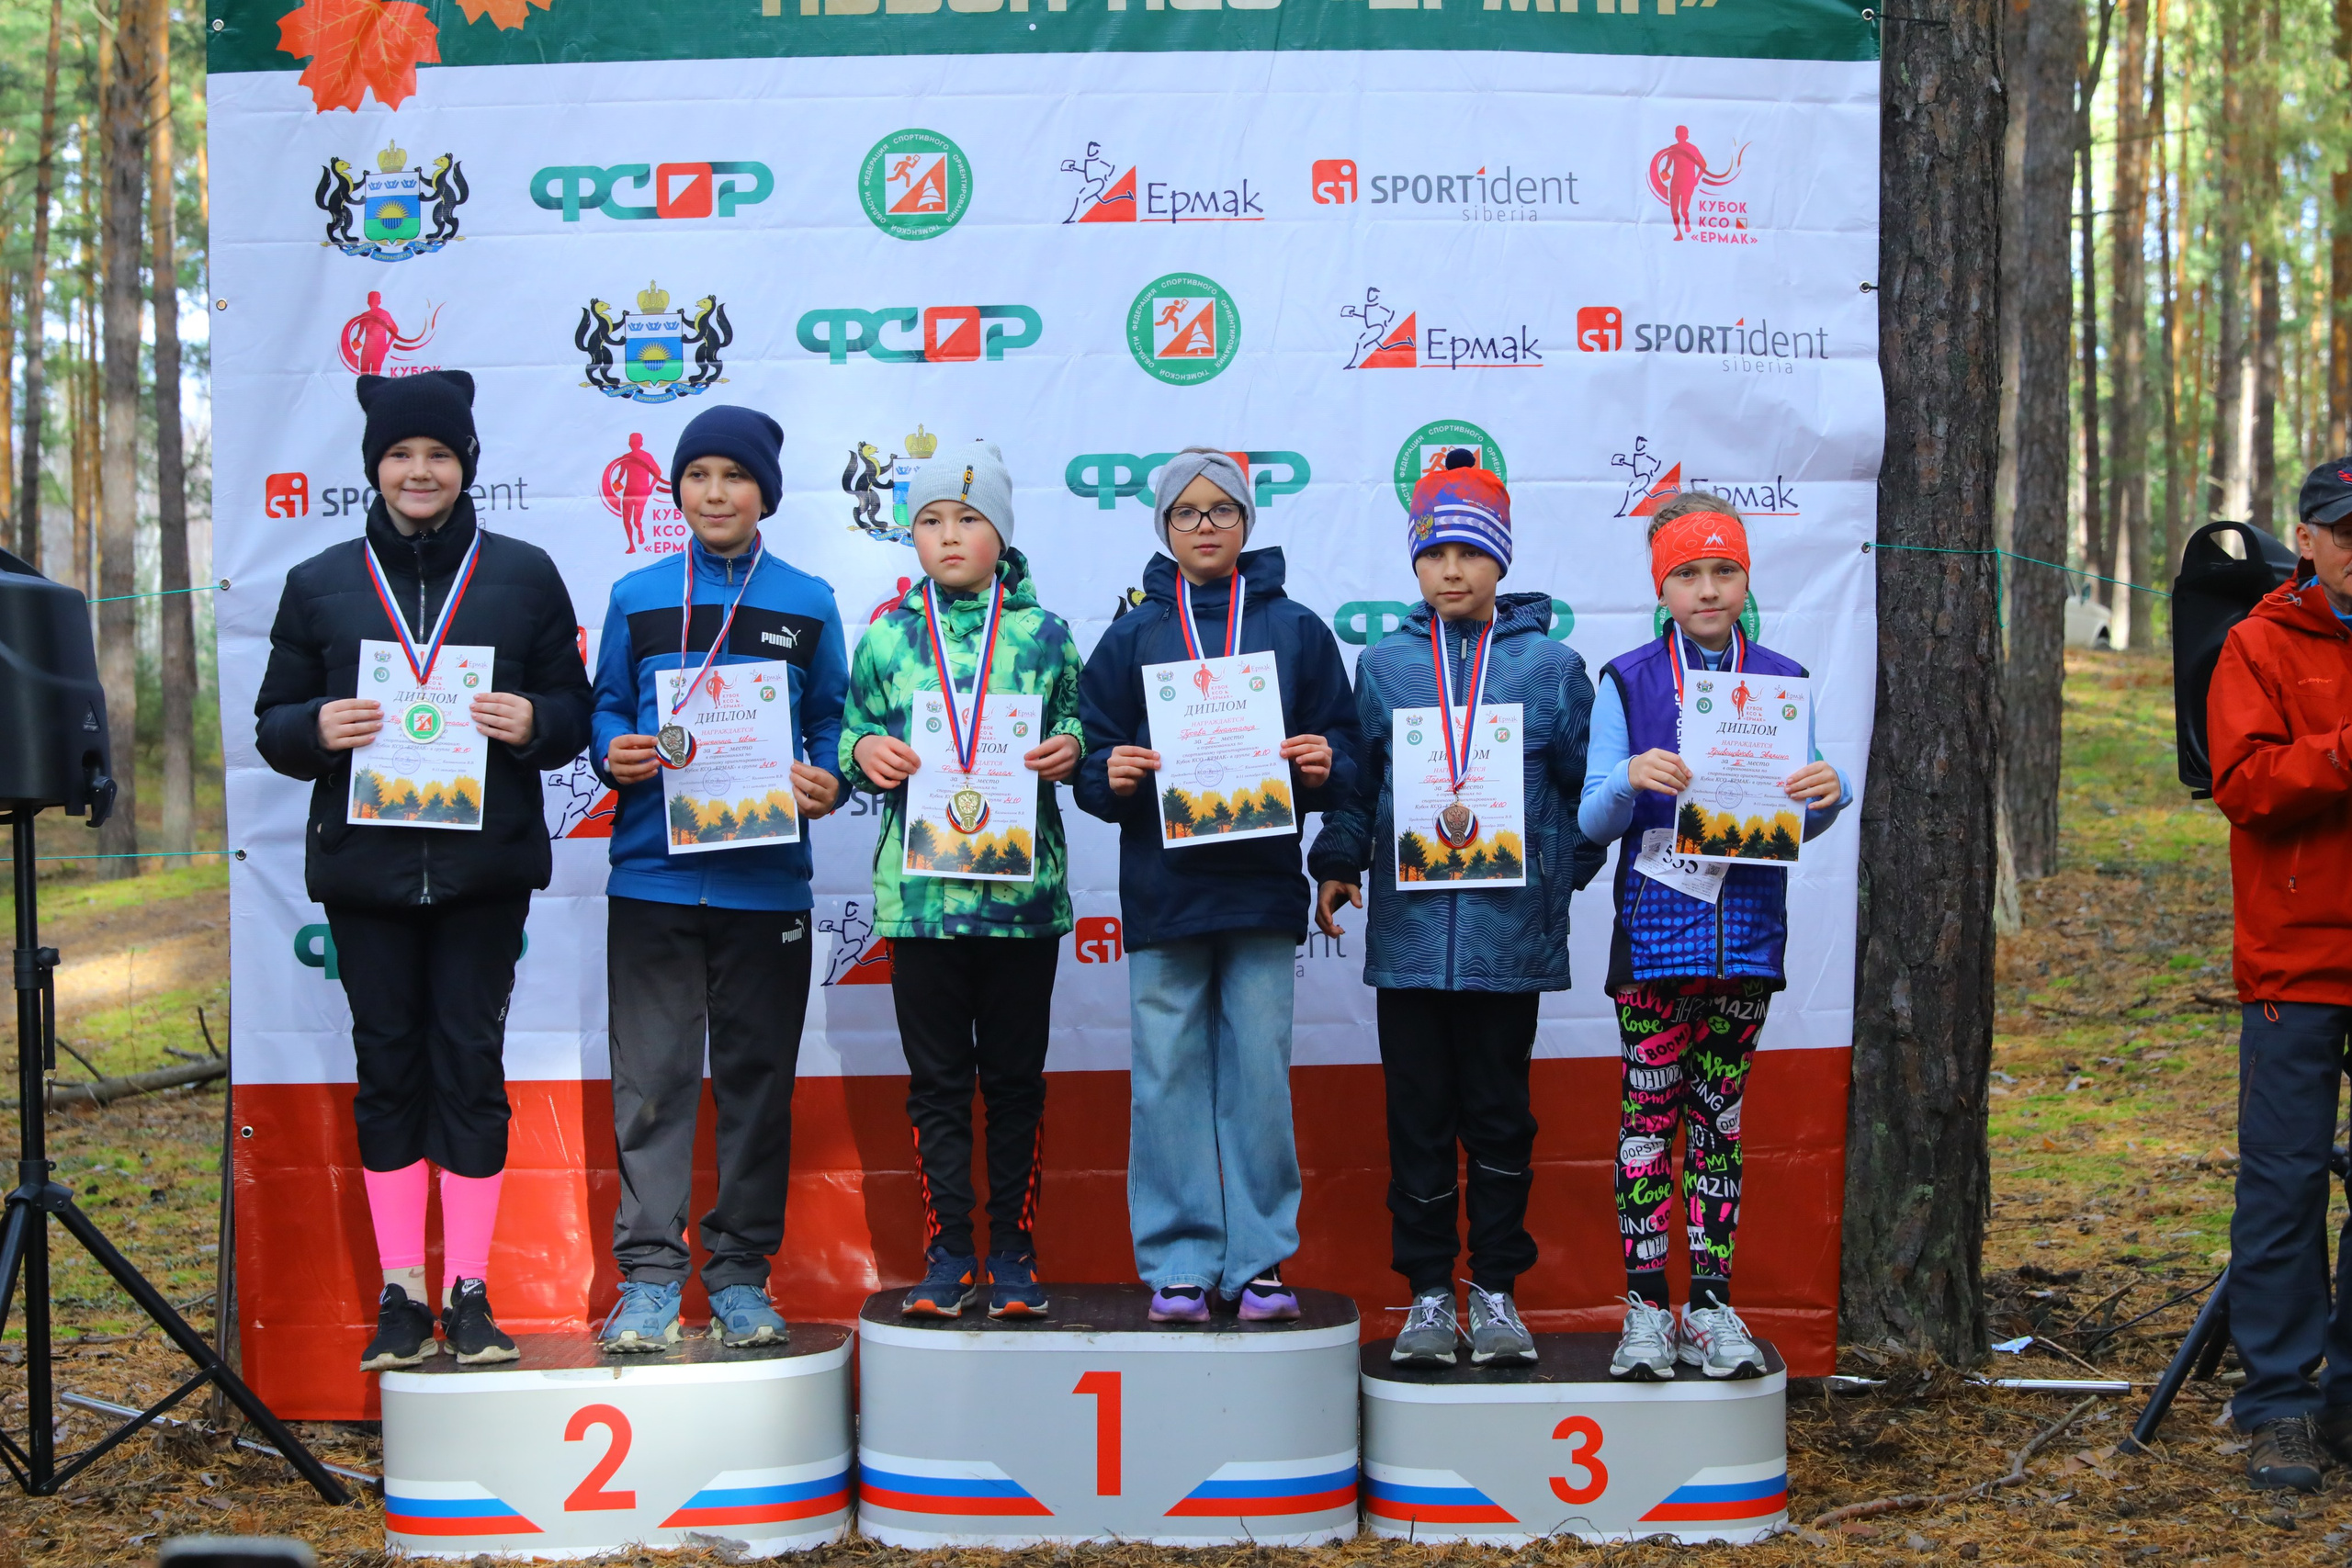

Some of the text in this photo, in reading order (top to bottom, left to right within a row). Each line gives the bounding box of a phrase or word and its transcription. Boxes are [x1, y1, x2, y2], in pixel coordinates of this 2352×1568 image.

[865, 134, 967, 235] ФЕДЕРАЦИЯ СПОРТИВНОГО ОРИЕНТИРОВАНИЯ ТЮМЕНСКОЙ ОБЛАСТИ
[1371, 165, 1579, 204] SPORTident
[1148, 179, 1263, 222] Ермак
[1699, 200, 1747, 214] КУБОК
[1462, 207, 1538, 222] siberia
[1699, 217, 1730, 230] КСО
[1690, 231, 1758, 244] «ЕРМАК»
[1132, 278, 1235, 380] ФЕДЕРАЦИЯ СПОРТИВНОГО ОРИЕНТИРОВАНИЯ ТЮМЕНСКОЙ ОБЛАСТИ
[1635, 316, 1829, 359] SPORTident
[1429, 325, 1543, 369] Ермак
[1722, 356, 1793, 374] siberia
[1399, 435, 1424, 478] ФЕДЕРАЦИЯ
[1429, 425, 1484, 442] СПОРТИВНОГО
[653, 525, 686, 536] КСО
[761, 631, 792, 649] PUMA
[1184, 699, 1247, 717] ДИПЛОМ
[695, 709, 757, 726] ДИПЛОМ
[1191, 716, 1245, 728] НАГРАЖДАЕТСЯ
[701, 727, 754, 736] НАГРАЖДАЕТСЯ
[1716, 721, 1778, 737] ДИПЛОМ
[1721, 739, 1773, 749] НАГРАЖДАЕТСЯ
[782, 927, 803, 943] PUMA
[1622, 1006, 1663, 1033] love
[1628, 1177, 1673, 1205] love
[1072, 1371, 1121, 1496] 1
[563, 1403, 636, 1513] 2
[1550, 1415, 1609, 1506] 3
